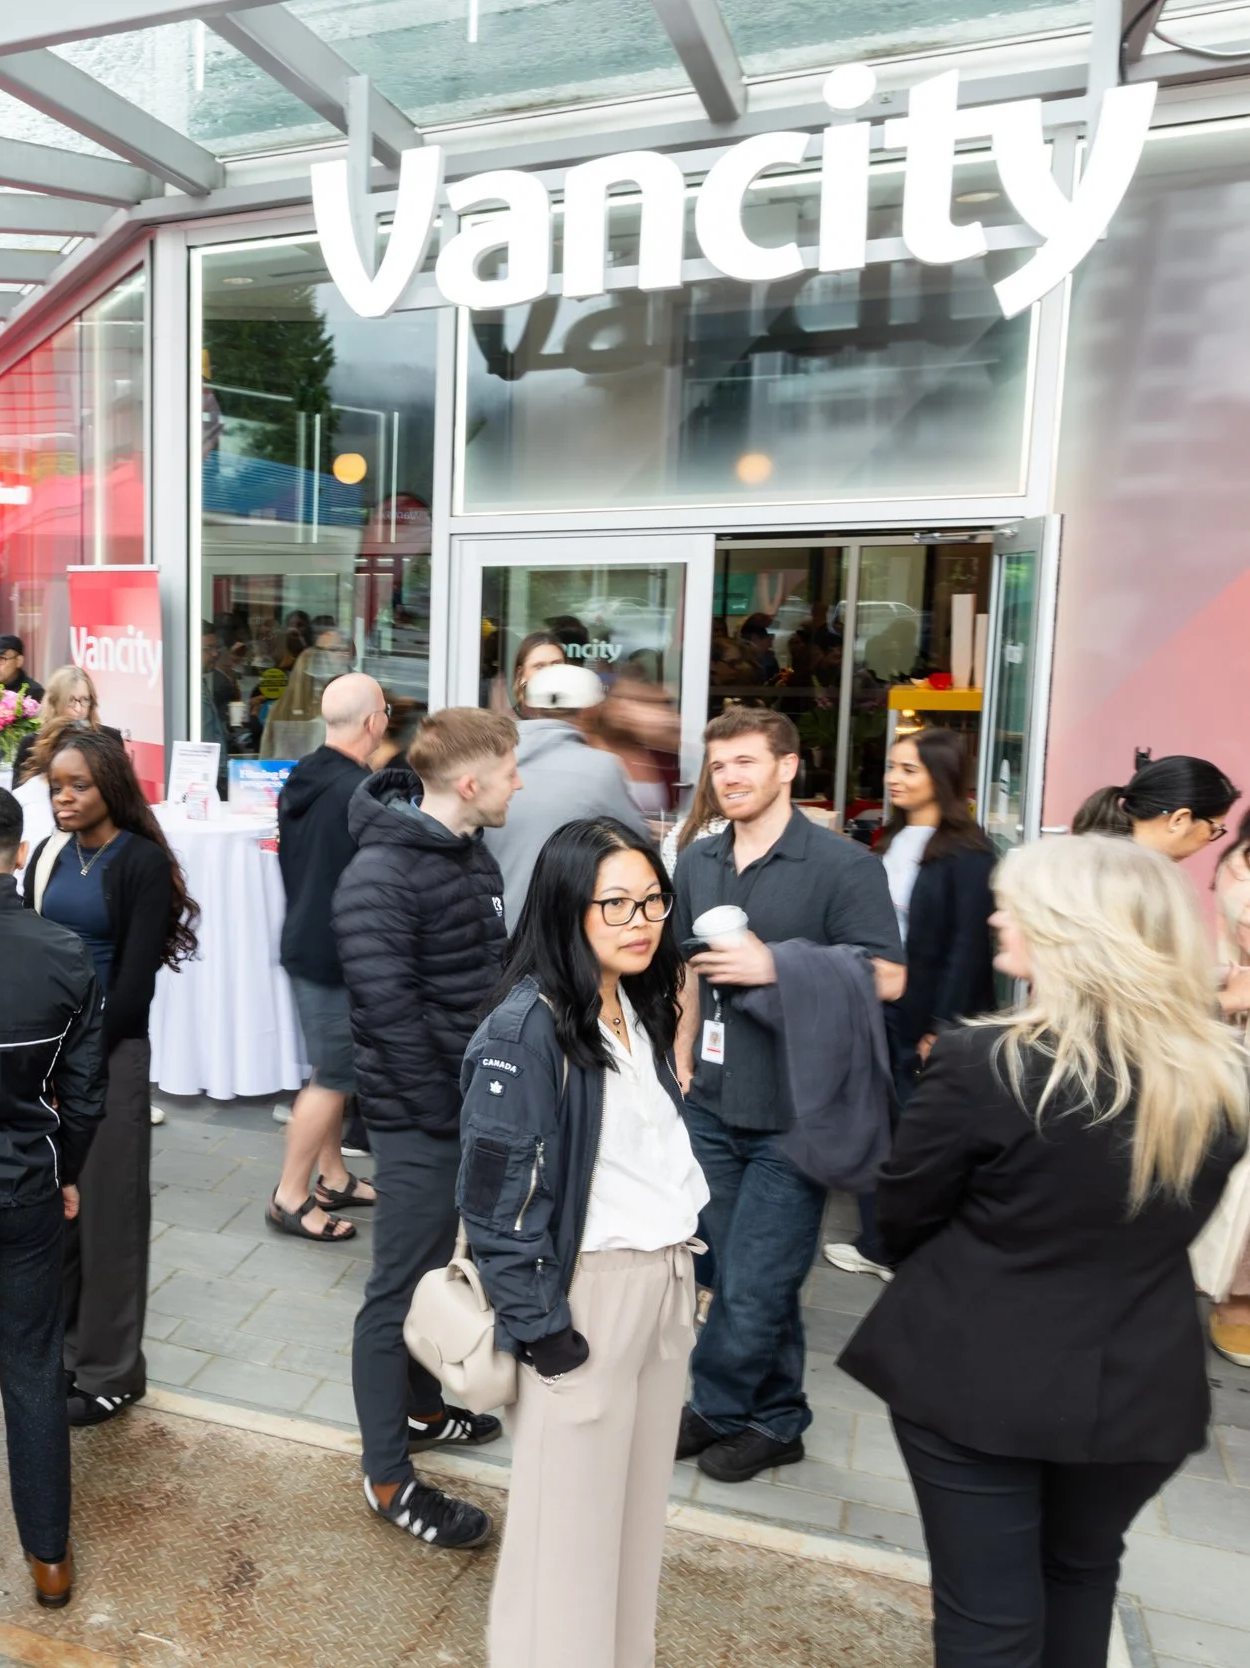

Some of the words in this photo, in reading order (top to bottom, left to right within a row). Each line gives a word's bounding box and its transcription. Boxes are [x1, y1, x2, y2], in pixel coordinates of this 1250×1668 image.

[310, 65, 1158, 318] Vancity
[70, 624, 162, 688] Vancity
[482, 1058, 518, 1073] CANADA
